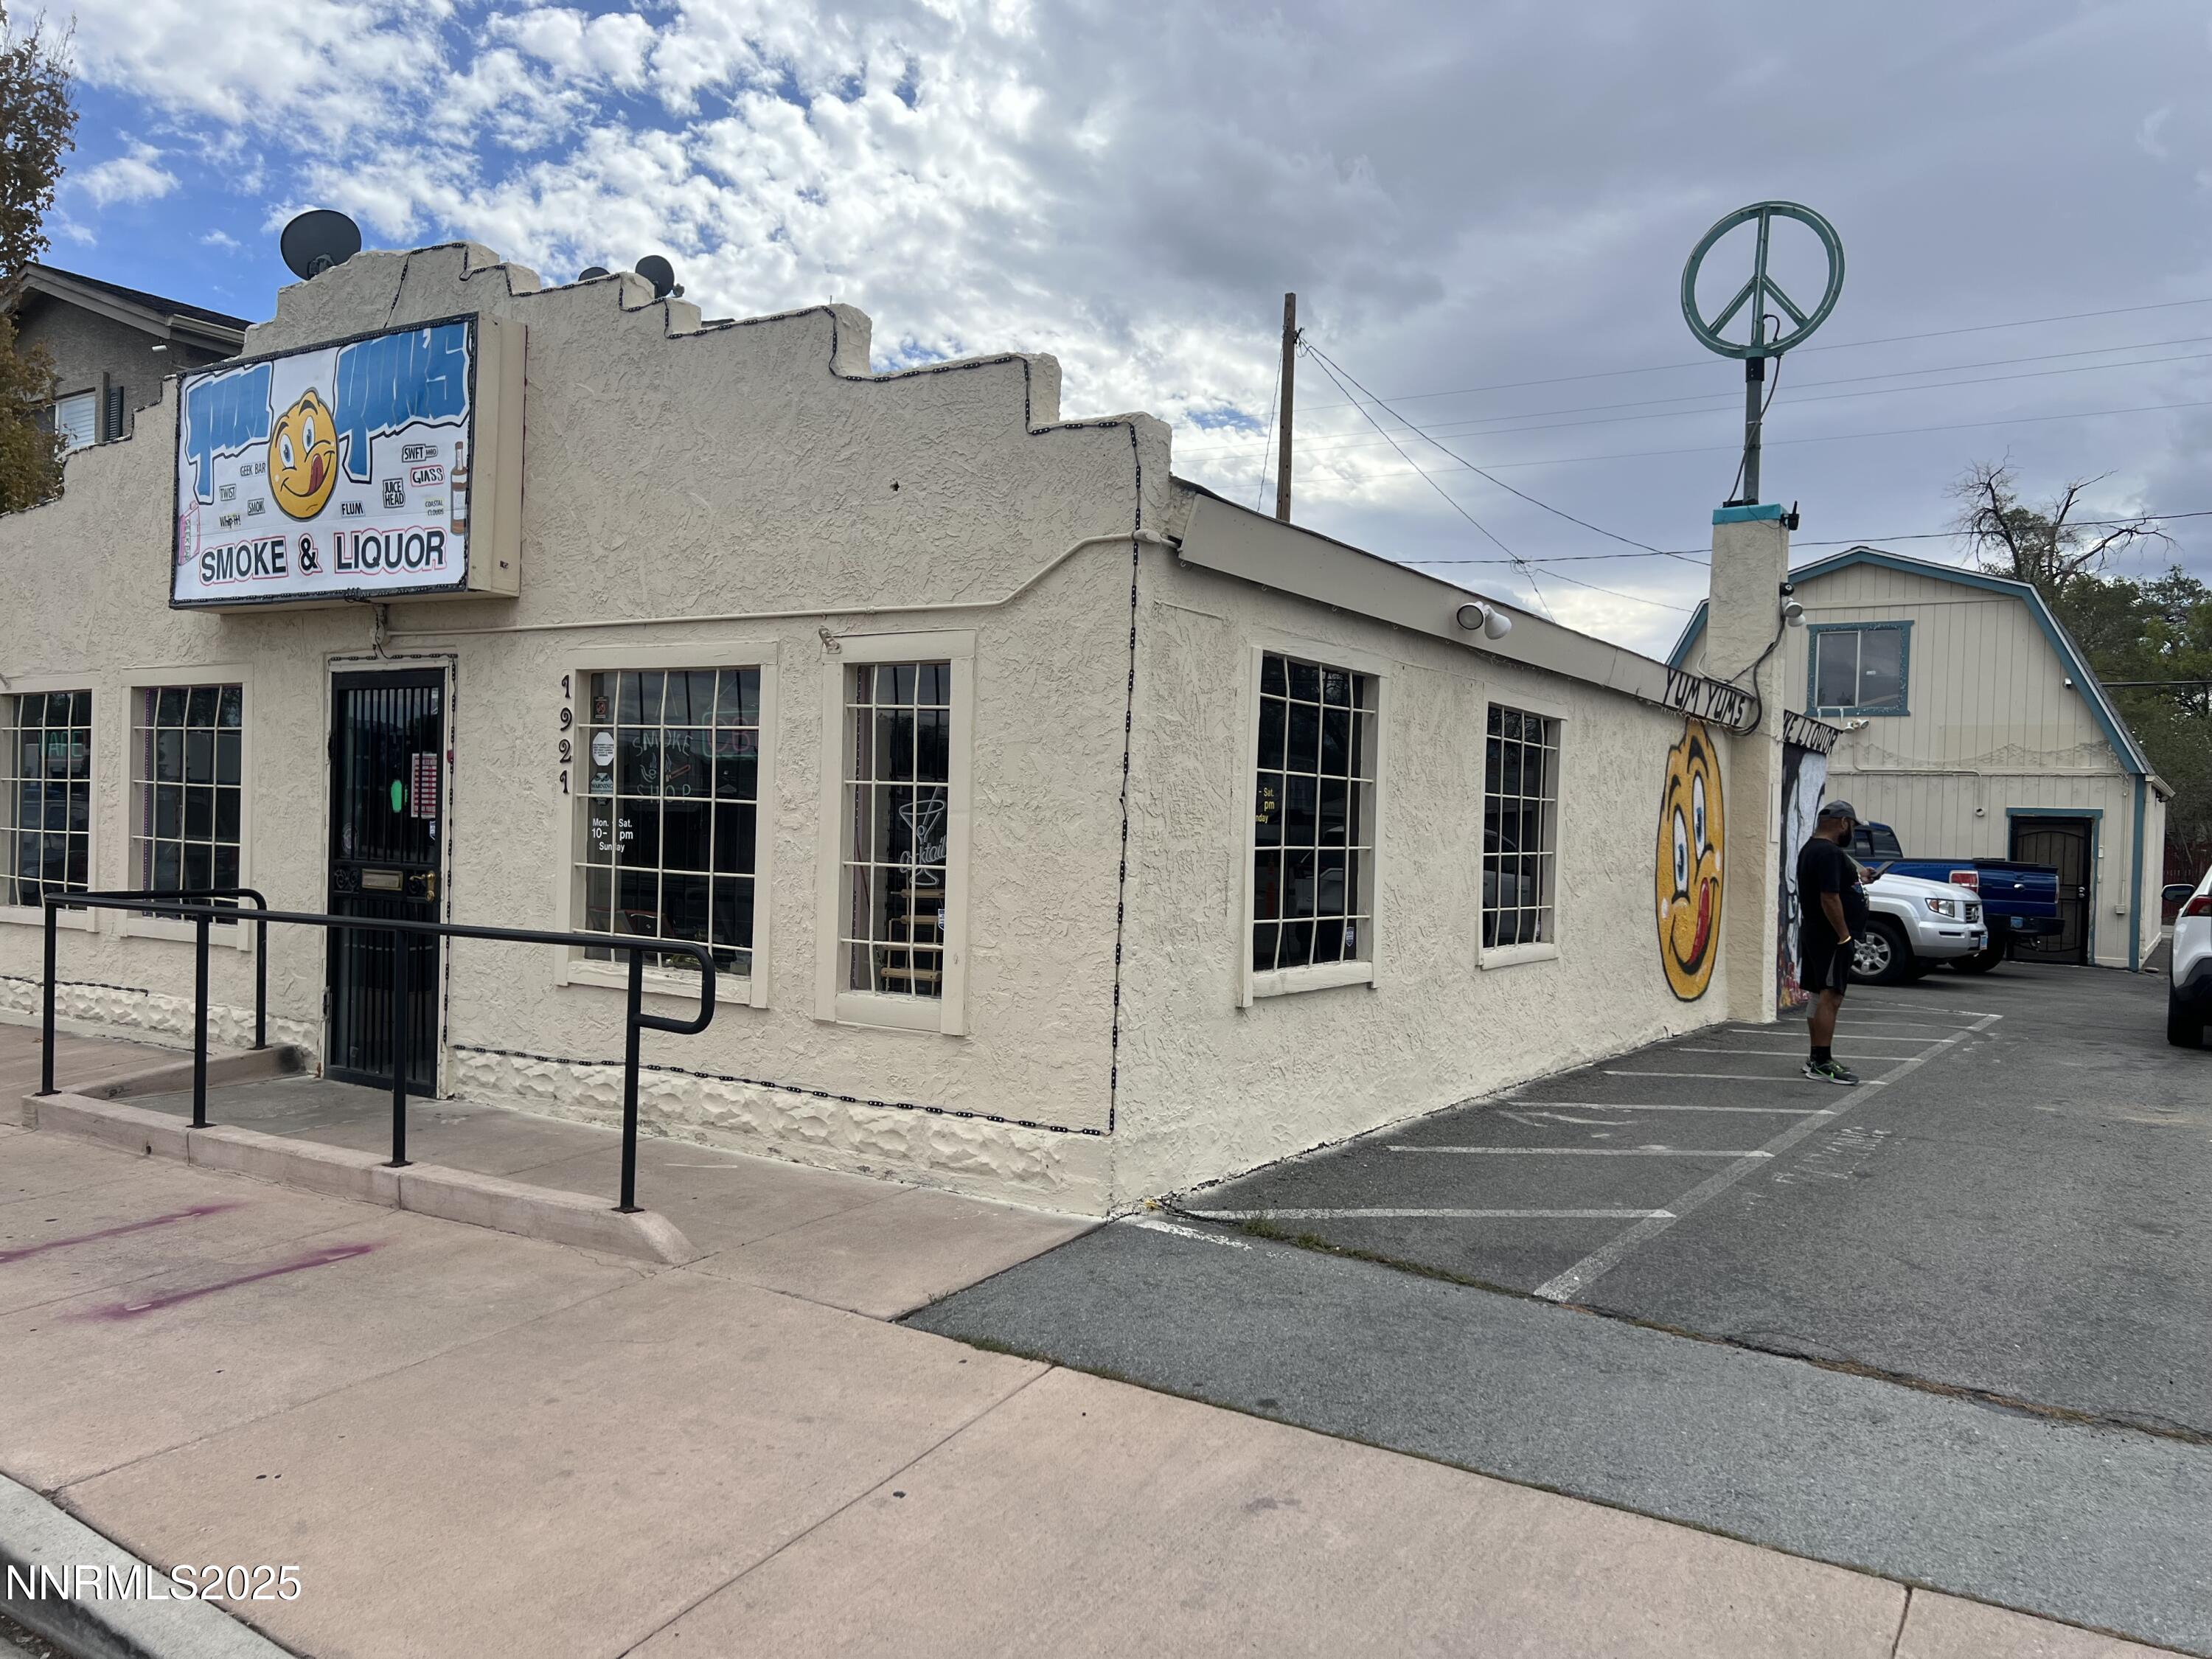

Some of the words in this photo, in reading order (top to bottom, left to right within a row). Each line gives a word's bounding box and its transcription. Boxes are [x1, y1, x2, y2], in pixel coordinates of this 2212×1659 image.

[404, 447, 424, 460] SWFT
[240, 465, 253, 476] GEEK
[254, 462, 266, 475] BAR
[220, 487, 235, 500] TWIST
[384, 481, 402, 494] JUICE
[384, 493, 405, 507] HEAD
[425, 500, 443, 509] COASTAL
[248, 501, 265, 515] SMOK
[341, 502, 364, 515] FLUM
[201, 540, 287, 582] SMOKE
[300, 538, 319, 571] &
[336, 530, 445, 570] LIQUOR
[1663, 667, 1702, 714] YUM
[1704, 683, 1746, 726] YUMS
[637, 784, 692, 804] SHOP
[1264, 801, 1275, 812] pm
[592, 818, 610, 827] Mon.
[618, 818, 633, 827] Sat.
[619, 831, 633, 841] pm
[599, 841, 625, 853] Sunay
